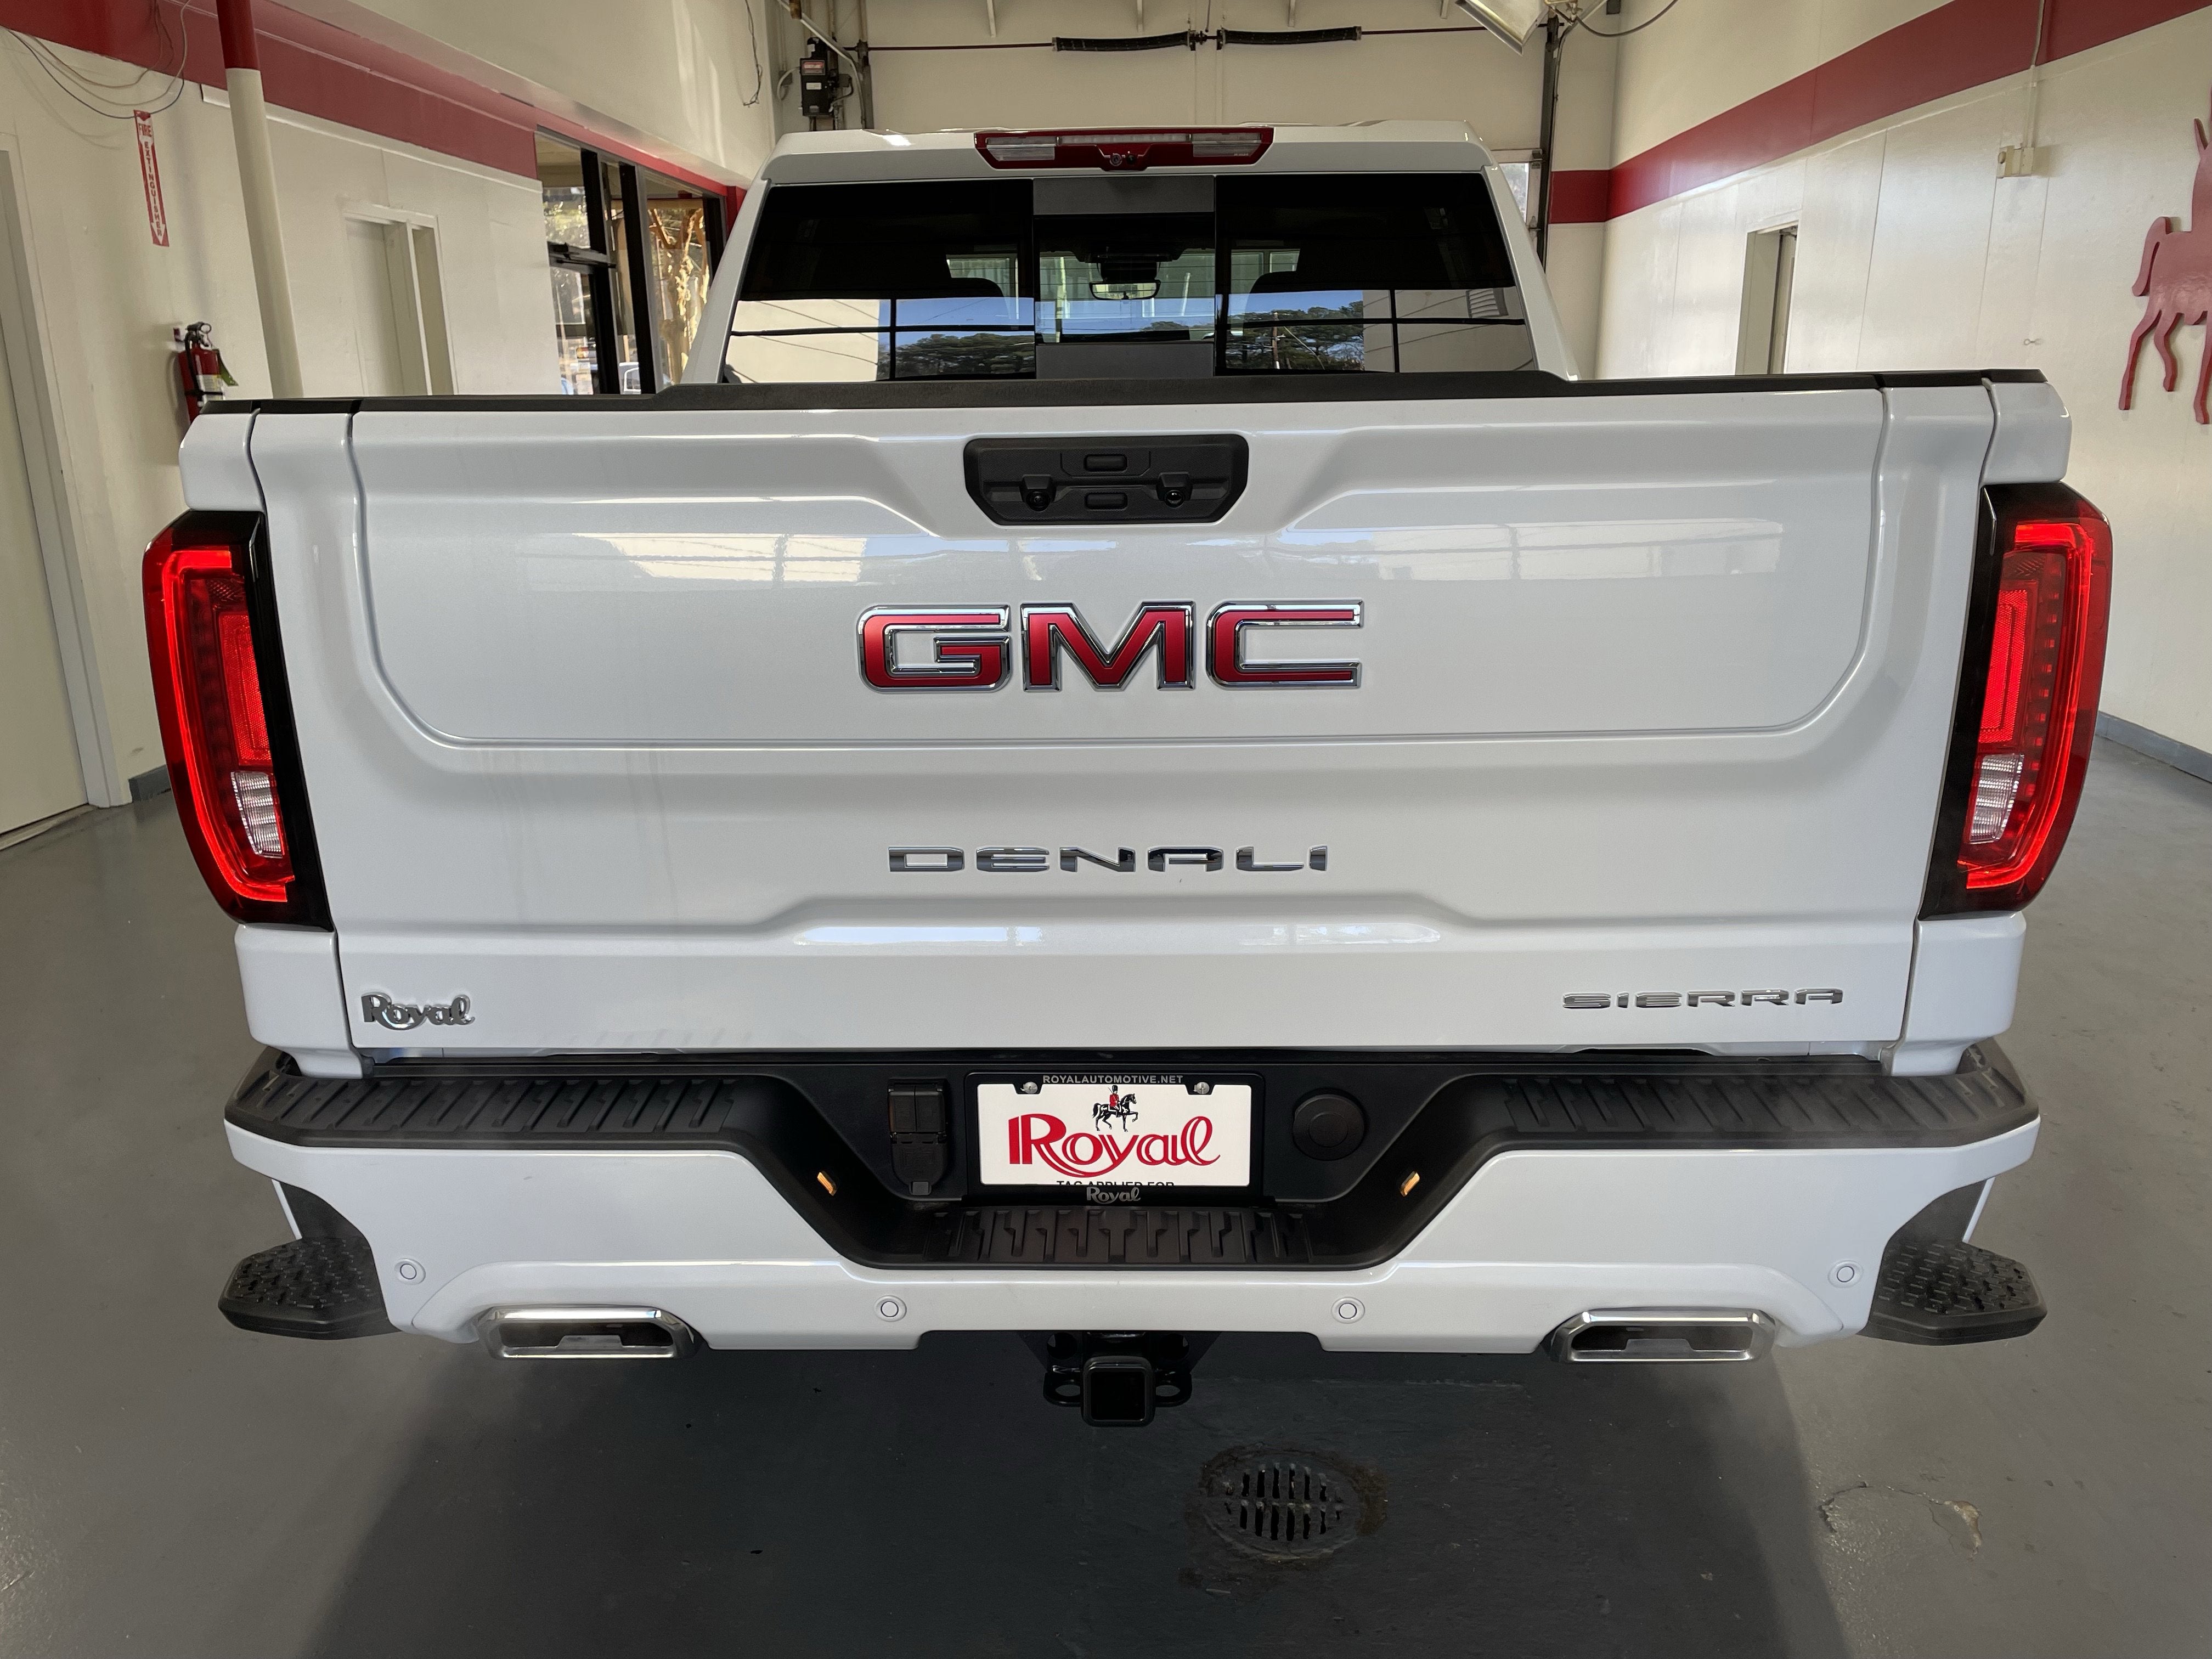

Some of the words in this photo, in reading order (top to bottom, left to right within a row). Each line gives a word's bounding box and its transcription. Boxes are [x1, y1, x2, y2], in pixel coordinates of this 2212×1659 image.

[138, 123, 152, 137] FIRE
[144, 141, 162, 236] EXTINGUISHER
[858, 601, 1363, 692] GMC
[888, 845, 1328, 872] DENALI
[361, 991, 476, 1031] Royal
[1563, 989, 1843, 1008] SIERRA
[1043, 1075, 1183, 1084] ROYALAUTOMOTIVE.NET
[1008, 1114, 1221, 1178] Royal
[1086, 1186, 1141, 1204] Royal
